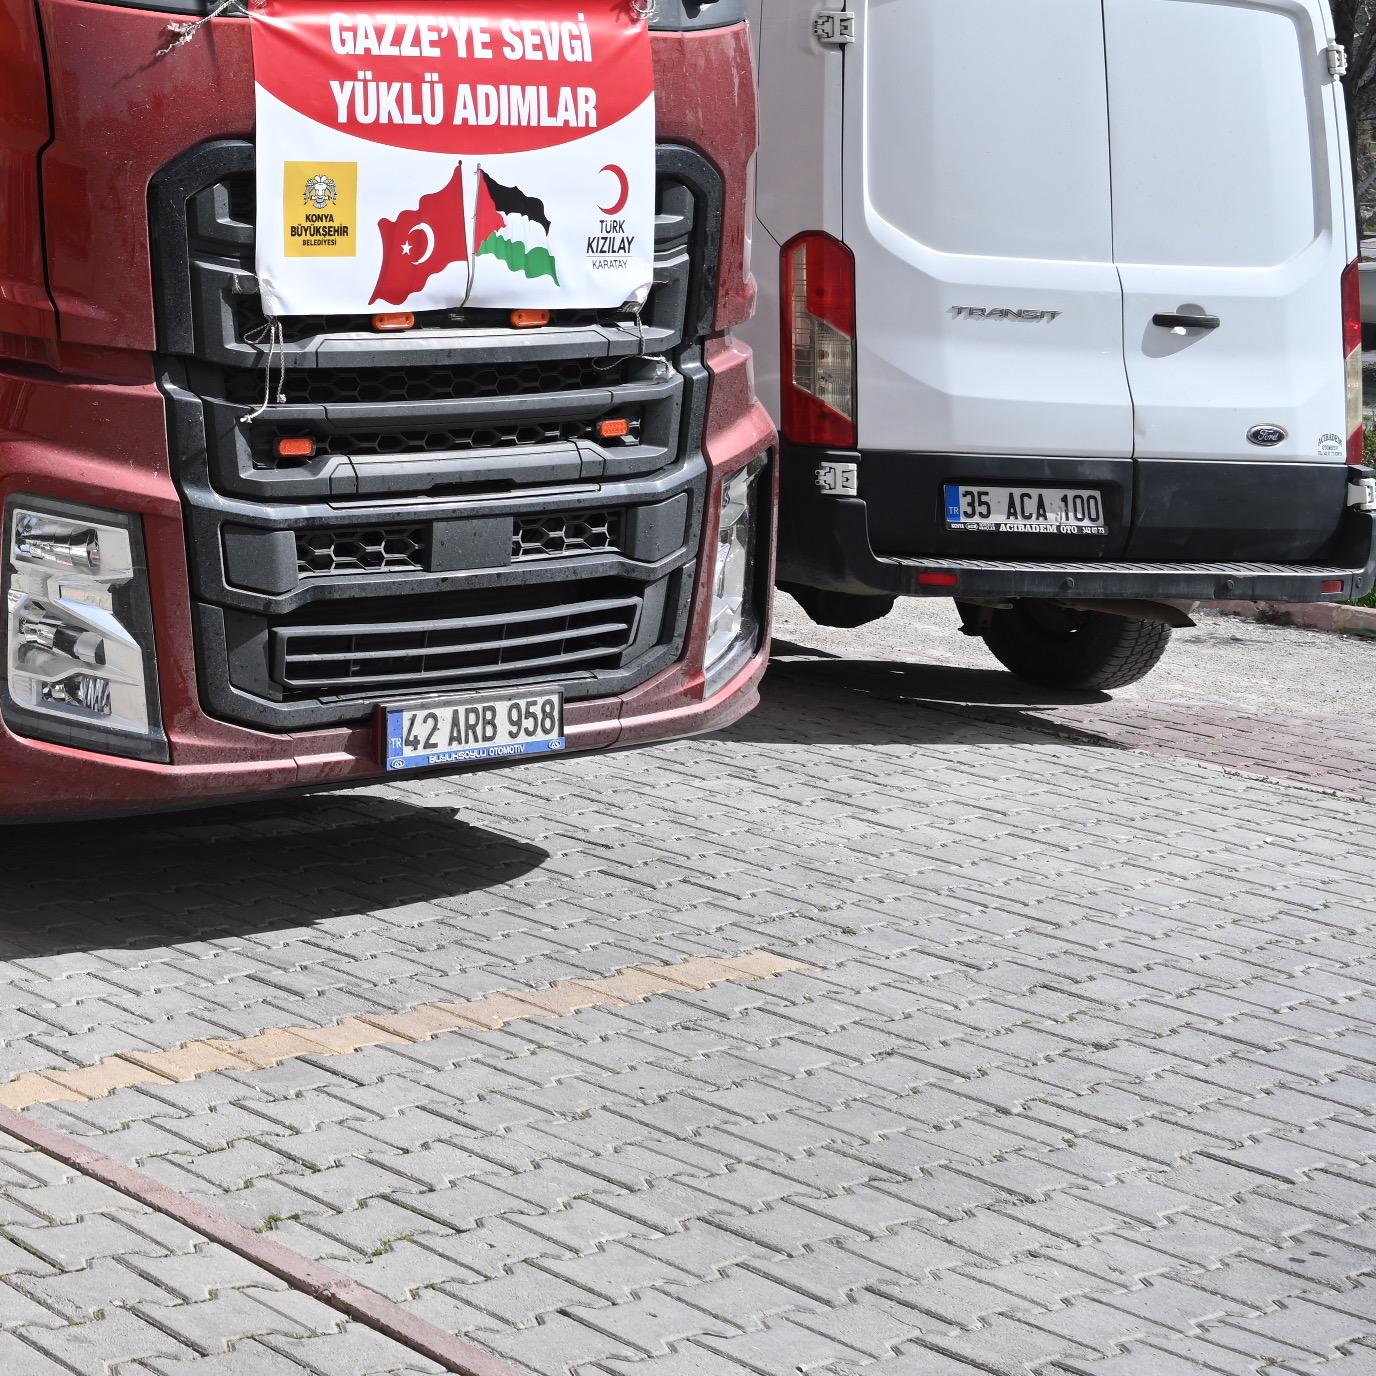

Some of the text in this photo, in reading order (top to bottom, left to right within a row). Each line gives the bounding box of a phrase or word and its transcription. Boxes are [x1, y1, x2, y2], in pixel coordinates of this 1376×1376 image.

[329, 12, 593, 62] GAZZE'YE SEVGİ
[329, 70, 598, 128] YÜKLÜ ADIMLAR
[305, 213, 335, 223] KONYA
[290, 223, 349, 238] BÜYÜKŞEHİR
[599, 219, 626, 234] TÜRK
[302, 237, 337, 246] BELEDİYESİ
[586, 236, 635, 254] KIZILAY
[591, 259, 628, 269] KARATAY
[950, 305, 1063, 321] TRANSIT
[1257, 429, 1279, 441] Ford
[948, 506, 959, 515] TR
[962, 490, 1100, 523] 35 ACA 100
[999, 523, 1058, 533] ACIBADEM
[1060, 525, 1078, 534] OTO
[404, 698, 556, 752] 42 ARB 958
[391, 737, 402, 749] TR
